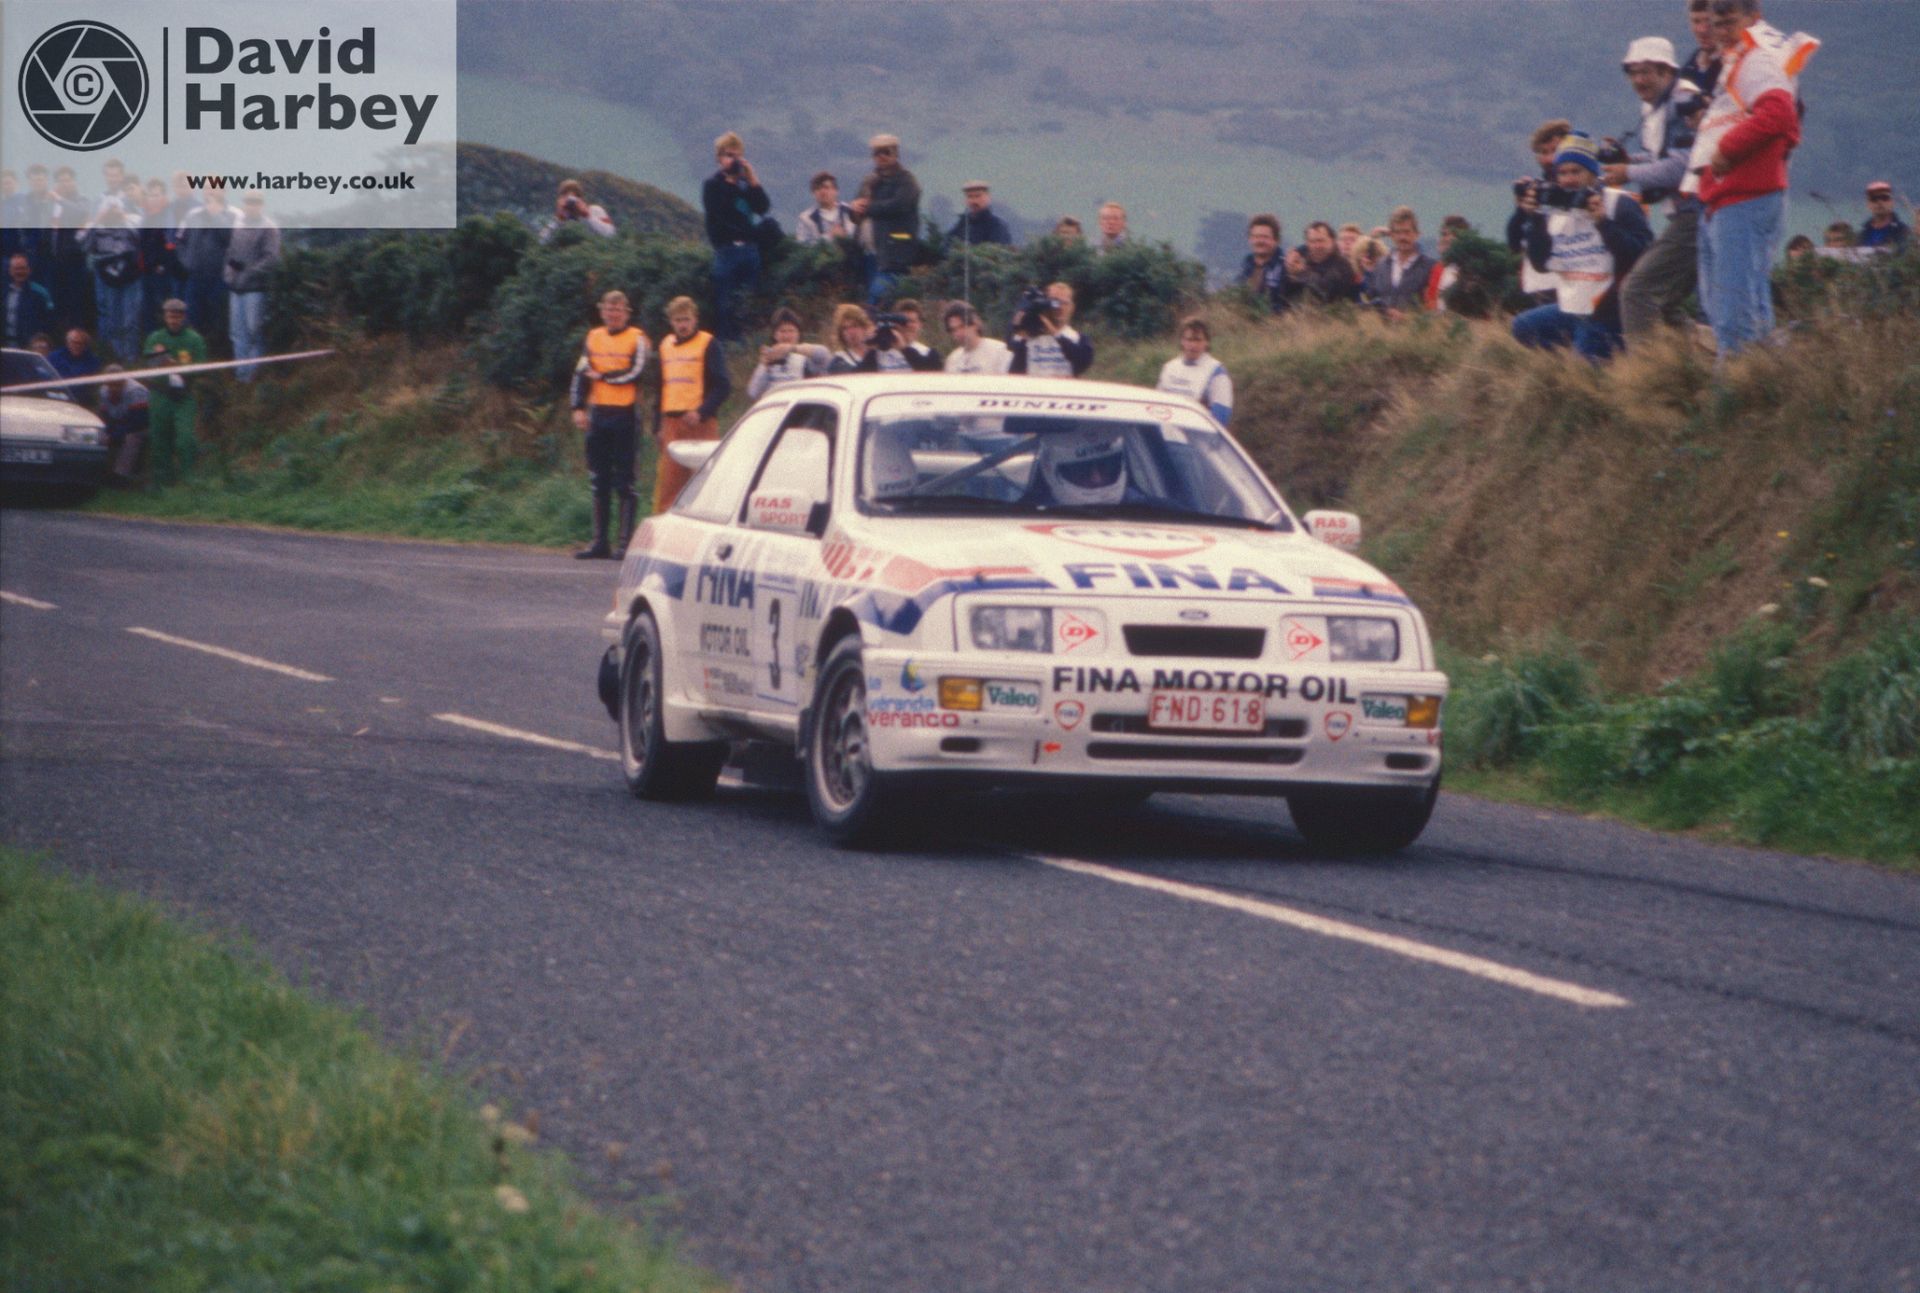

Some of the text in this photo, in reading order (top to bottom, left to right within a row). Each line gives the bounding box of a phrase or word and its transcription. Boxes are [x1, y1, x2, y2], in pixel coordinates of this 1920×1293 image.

[978, 398, 1107, 412] DUNLOP
[754, 496, 792, 509] RAS
[1315, 517, 1347, 529] RAS
[696, 564, 755, 610] FINA
[1063, 562, 1293, 595] FINA
[1053, 666, 1357, 705] FINA MOTOR OIL
[987, 686, 1038, 707] Valeo
[867, 711, 960, 728] veranco
[1361, 698, 1405, 720] Valeo
